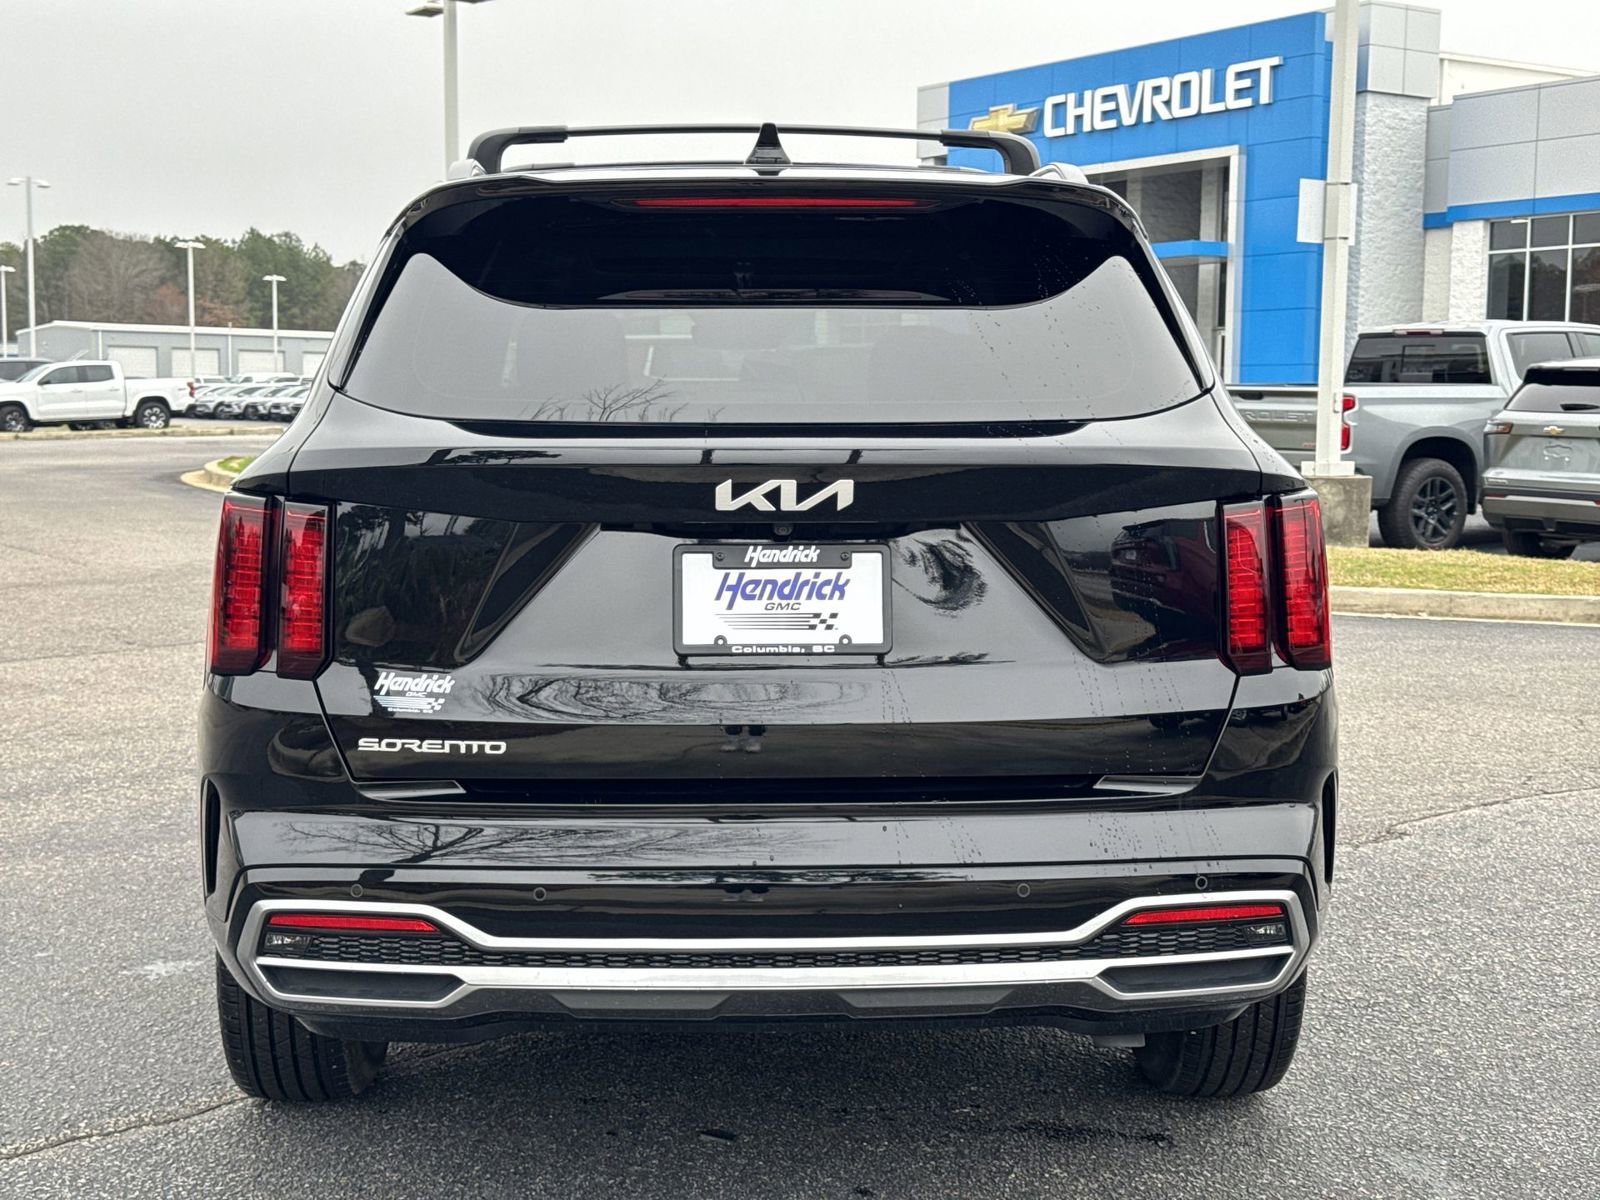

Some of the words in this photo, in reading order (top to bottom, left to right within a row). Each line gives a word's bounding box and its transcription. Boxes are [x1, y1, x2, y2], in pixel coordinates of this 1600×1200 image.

[1043, 55, 1284, 138] CHEVROLET
[714, 478, 855, 512] KIA
[744, 545, 821, 568] Hendrick
[714, 571, 851, 611] Hendrick
[764, 602, 802, 611] GMC
[731, 645, 805, 654] Columbia,
[812, 645, 836, 653] SC
[373, 671, 456, 696] Hendrick
[357, 737, 507, 755] SORENTO
